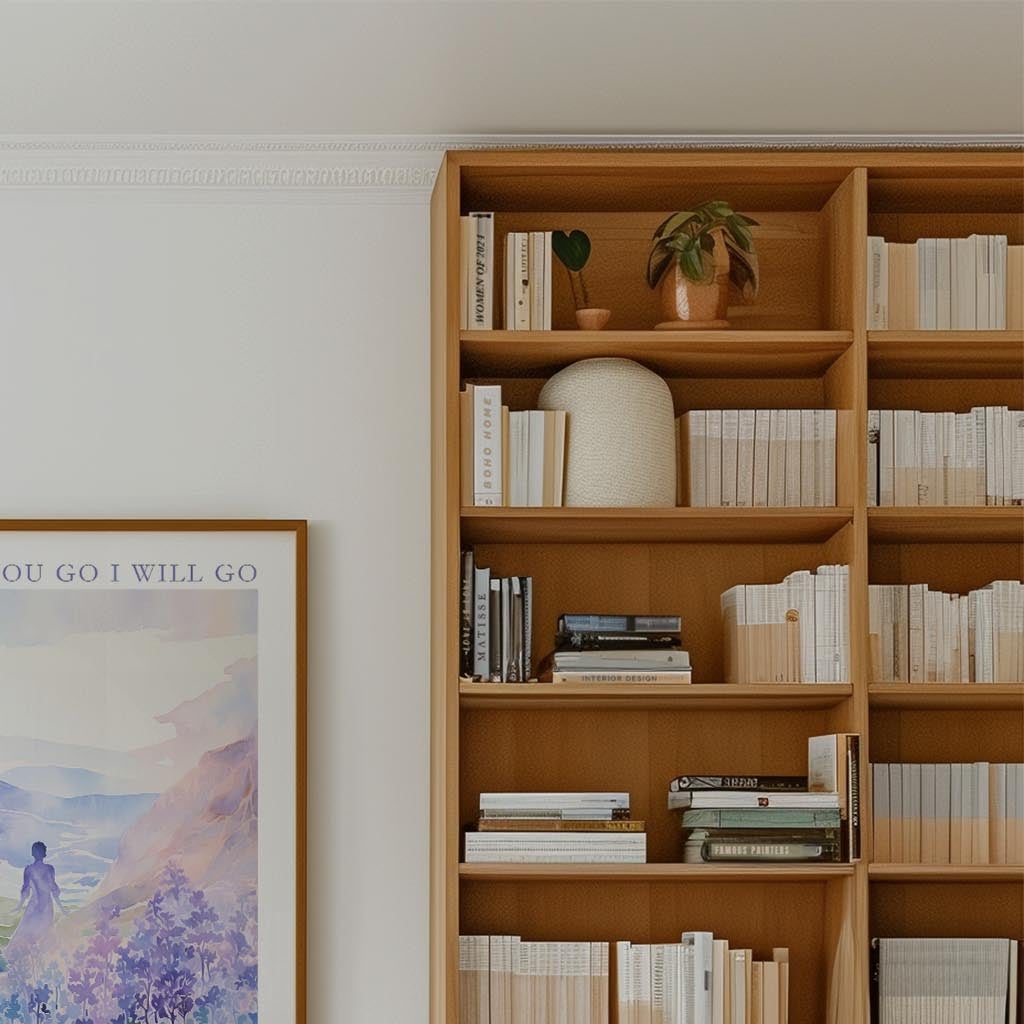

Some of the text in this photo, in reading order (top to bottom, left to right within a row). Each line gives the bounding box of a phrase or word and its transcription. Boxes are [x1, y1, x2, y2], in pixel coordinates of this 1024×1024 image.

[476, 259, 485, 276] OF
[475, 278, 484, 322] WOMEN
[483, 398, 492, 489] BOHO HOME
[56, 564, 98, 583] GO
[110, 564, 120, 582] I
[132, 564, 203, 583] WILL
[214, 564, 258, 583] GO
[477, 592, 486, 662] MATISSE
[714, 845, 790, 855] FAMOUS PAINTERS
